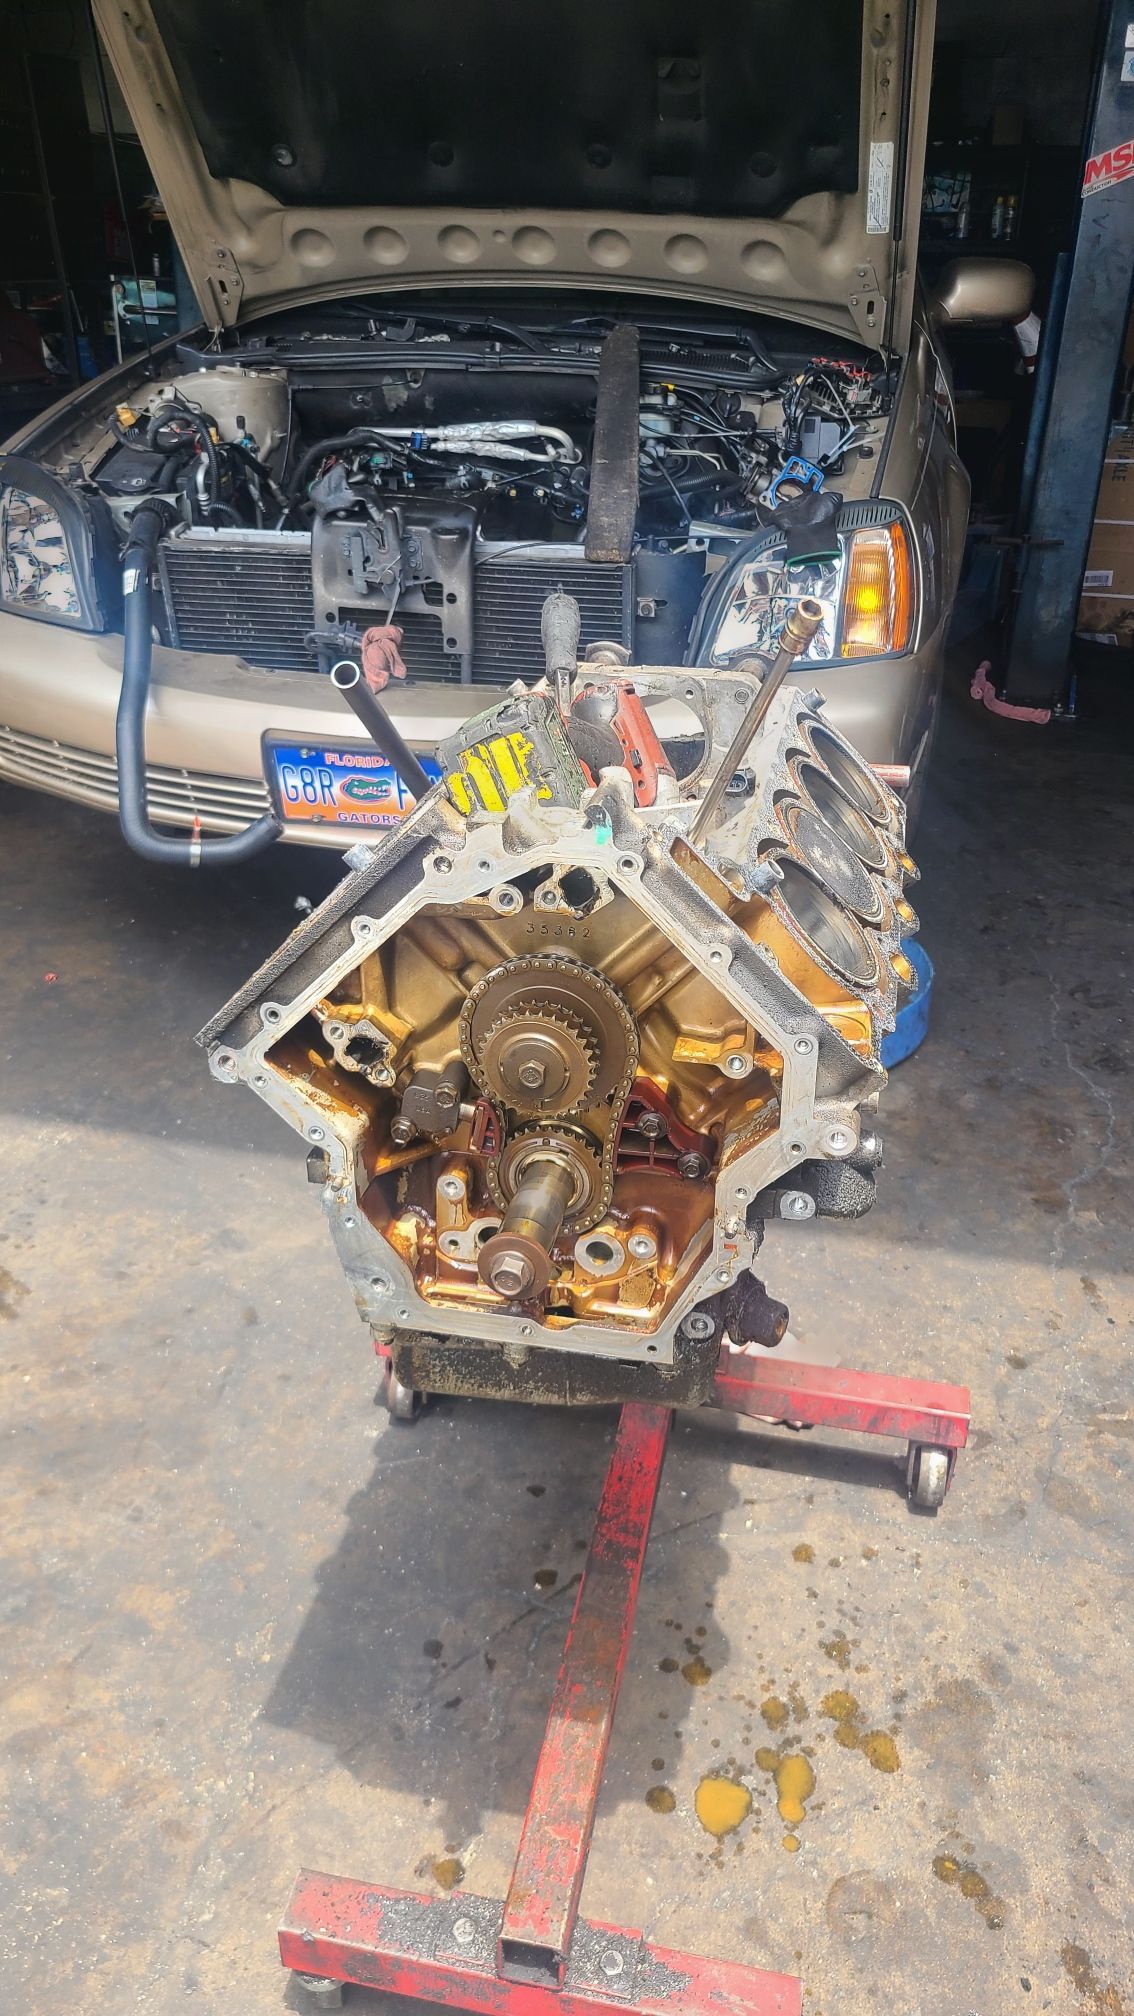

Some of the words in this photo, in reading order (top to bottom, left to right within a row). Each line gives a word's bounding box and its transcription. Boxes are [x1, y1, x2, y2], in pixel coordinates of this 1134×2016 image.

[1084, 143, 1134, 185] MS
[281, 765, 338, 806] G8R
[337, 812, 402, 825] GATORS
